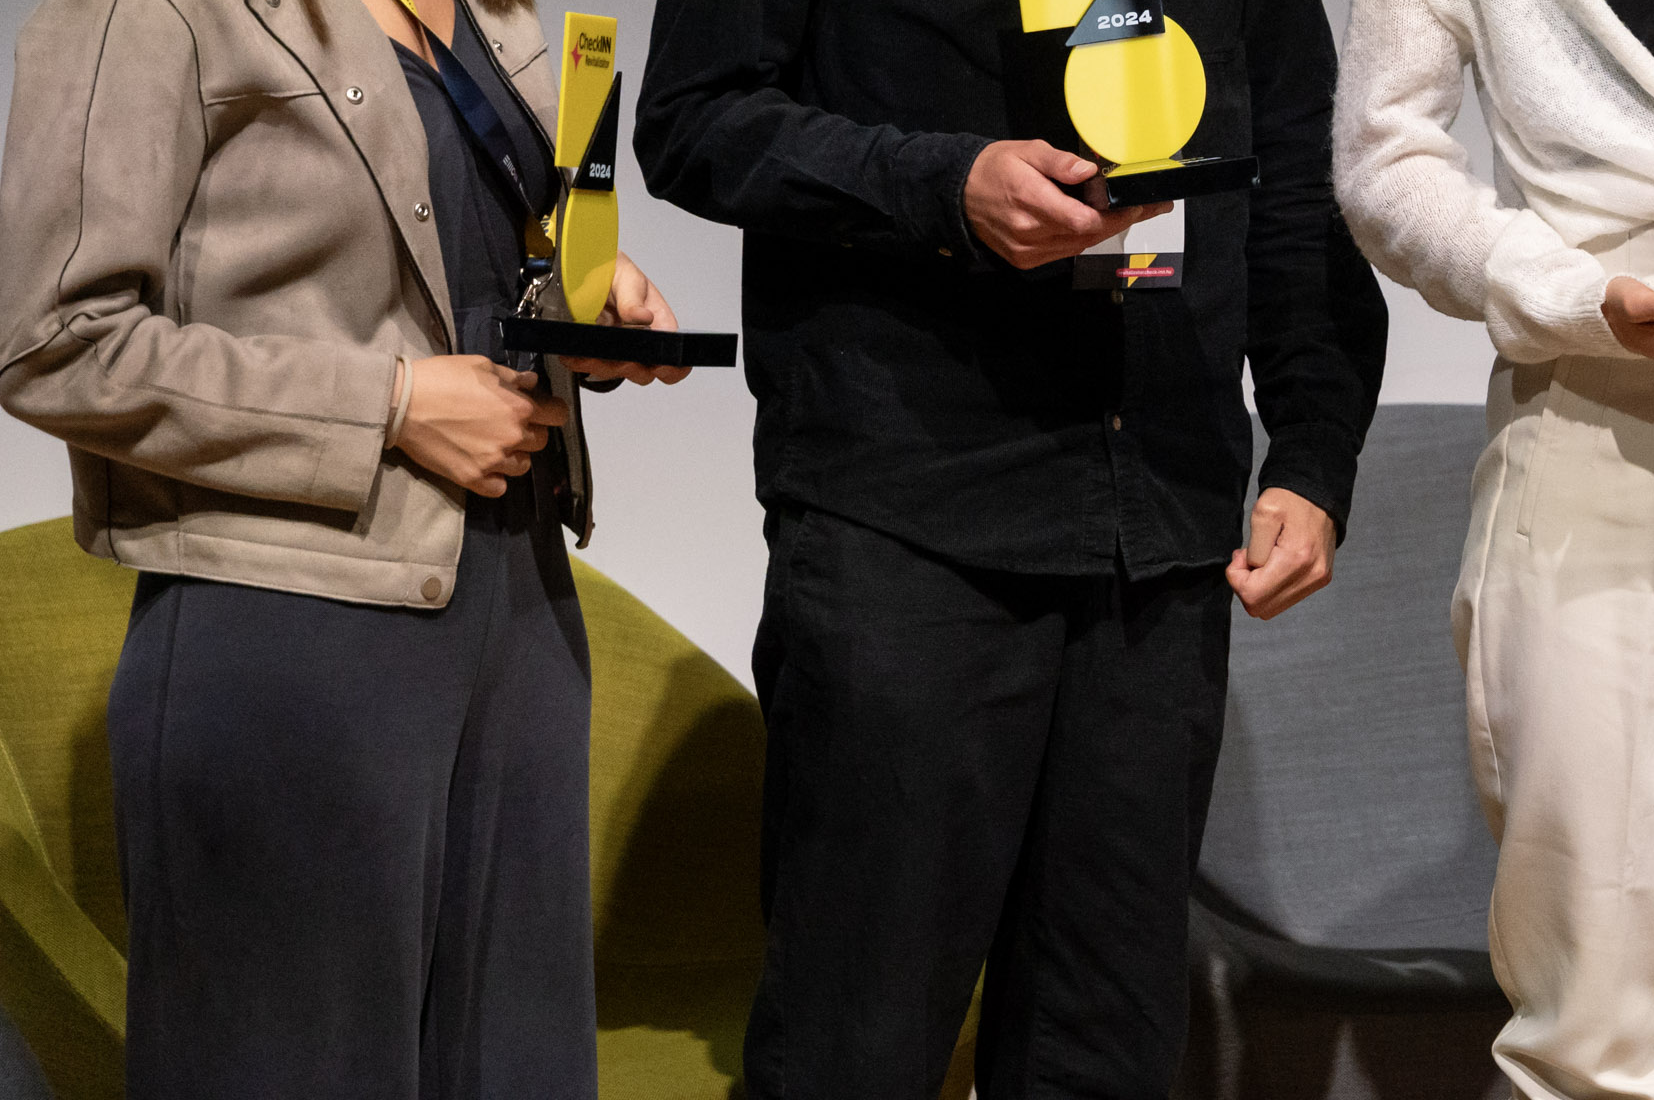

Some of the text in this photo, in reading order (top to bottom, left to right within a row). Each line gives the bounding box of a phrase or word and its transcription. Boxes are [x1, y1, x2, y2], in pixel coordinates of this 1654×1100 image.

[1097, 9, 1153, 30] 2024
[578, 31, 612, 55] CheckINN
[589, 162, 612, 179] 2024
